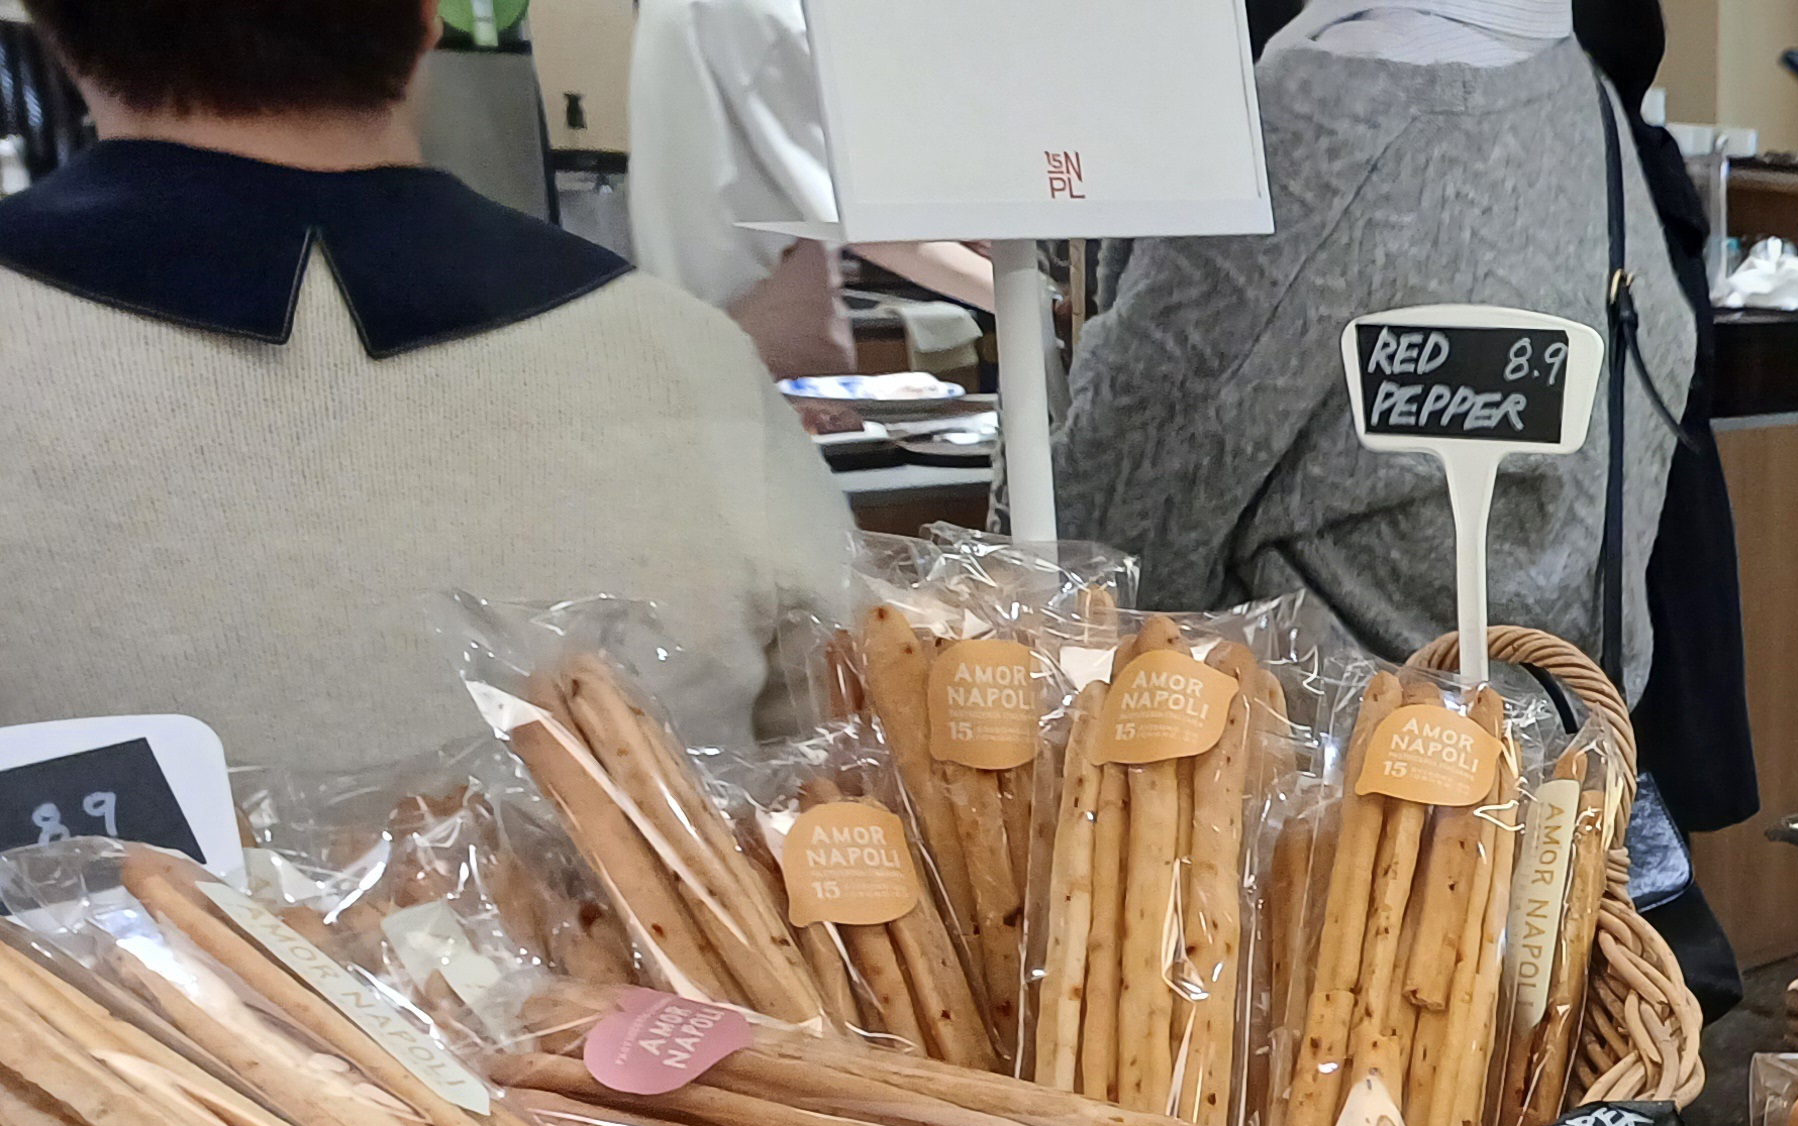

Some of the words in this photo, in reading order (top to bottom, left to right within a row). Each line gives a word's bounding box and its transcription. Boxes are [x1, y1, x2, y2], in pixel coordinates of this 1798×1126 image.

[1367, 326, 1450, 375] RED
[1503, 337, 1569, 386] 8.9
[1370, 380, 1528, 432] PEPPER
[954, 662, 1028, 686] AMOR
[1132, 670, 1204, 697] AMOR
[947, 685, 1035, 710] NAPOLI
[1120, 691, 1209, 720] NAPOLI
[949, 721, 974, 741] 15
[1114, 722, 1137, 741] 15
[1402, 717, 1475, 753] AMOR
[1390, 733, 1479, 774] NAPOLI
[1383, 760, 1408, 778] 15
[811, 825, 887, 847] AMOR
[1531, 802, 1565, 887] AMOR
[805, 847, 901, 869] NAPOLI
[811, 880, 841, 900] 15
[1517, 898, 1550, 1008] NAPOLI
[241, 901, 340, 981] AMOR
[342, 988, 468, 1088] NAPOLI
[638, 1005, 693, 1056] AMOR
[662, 1007, 725, 1069] NAPOLI
